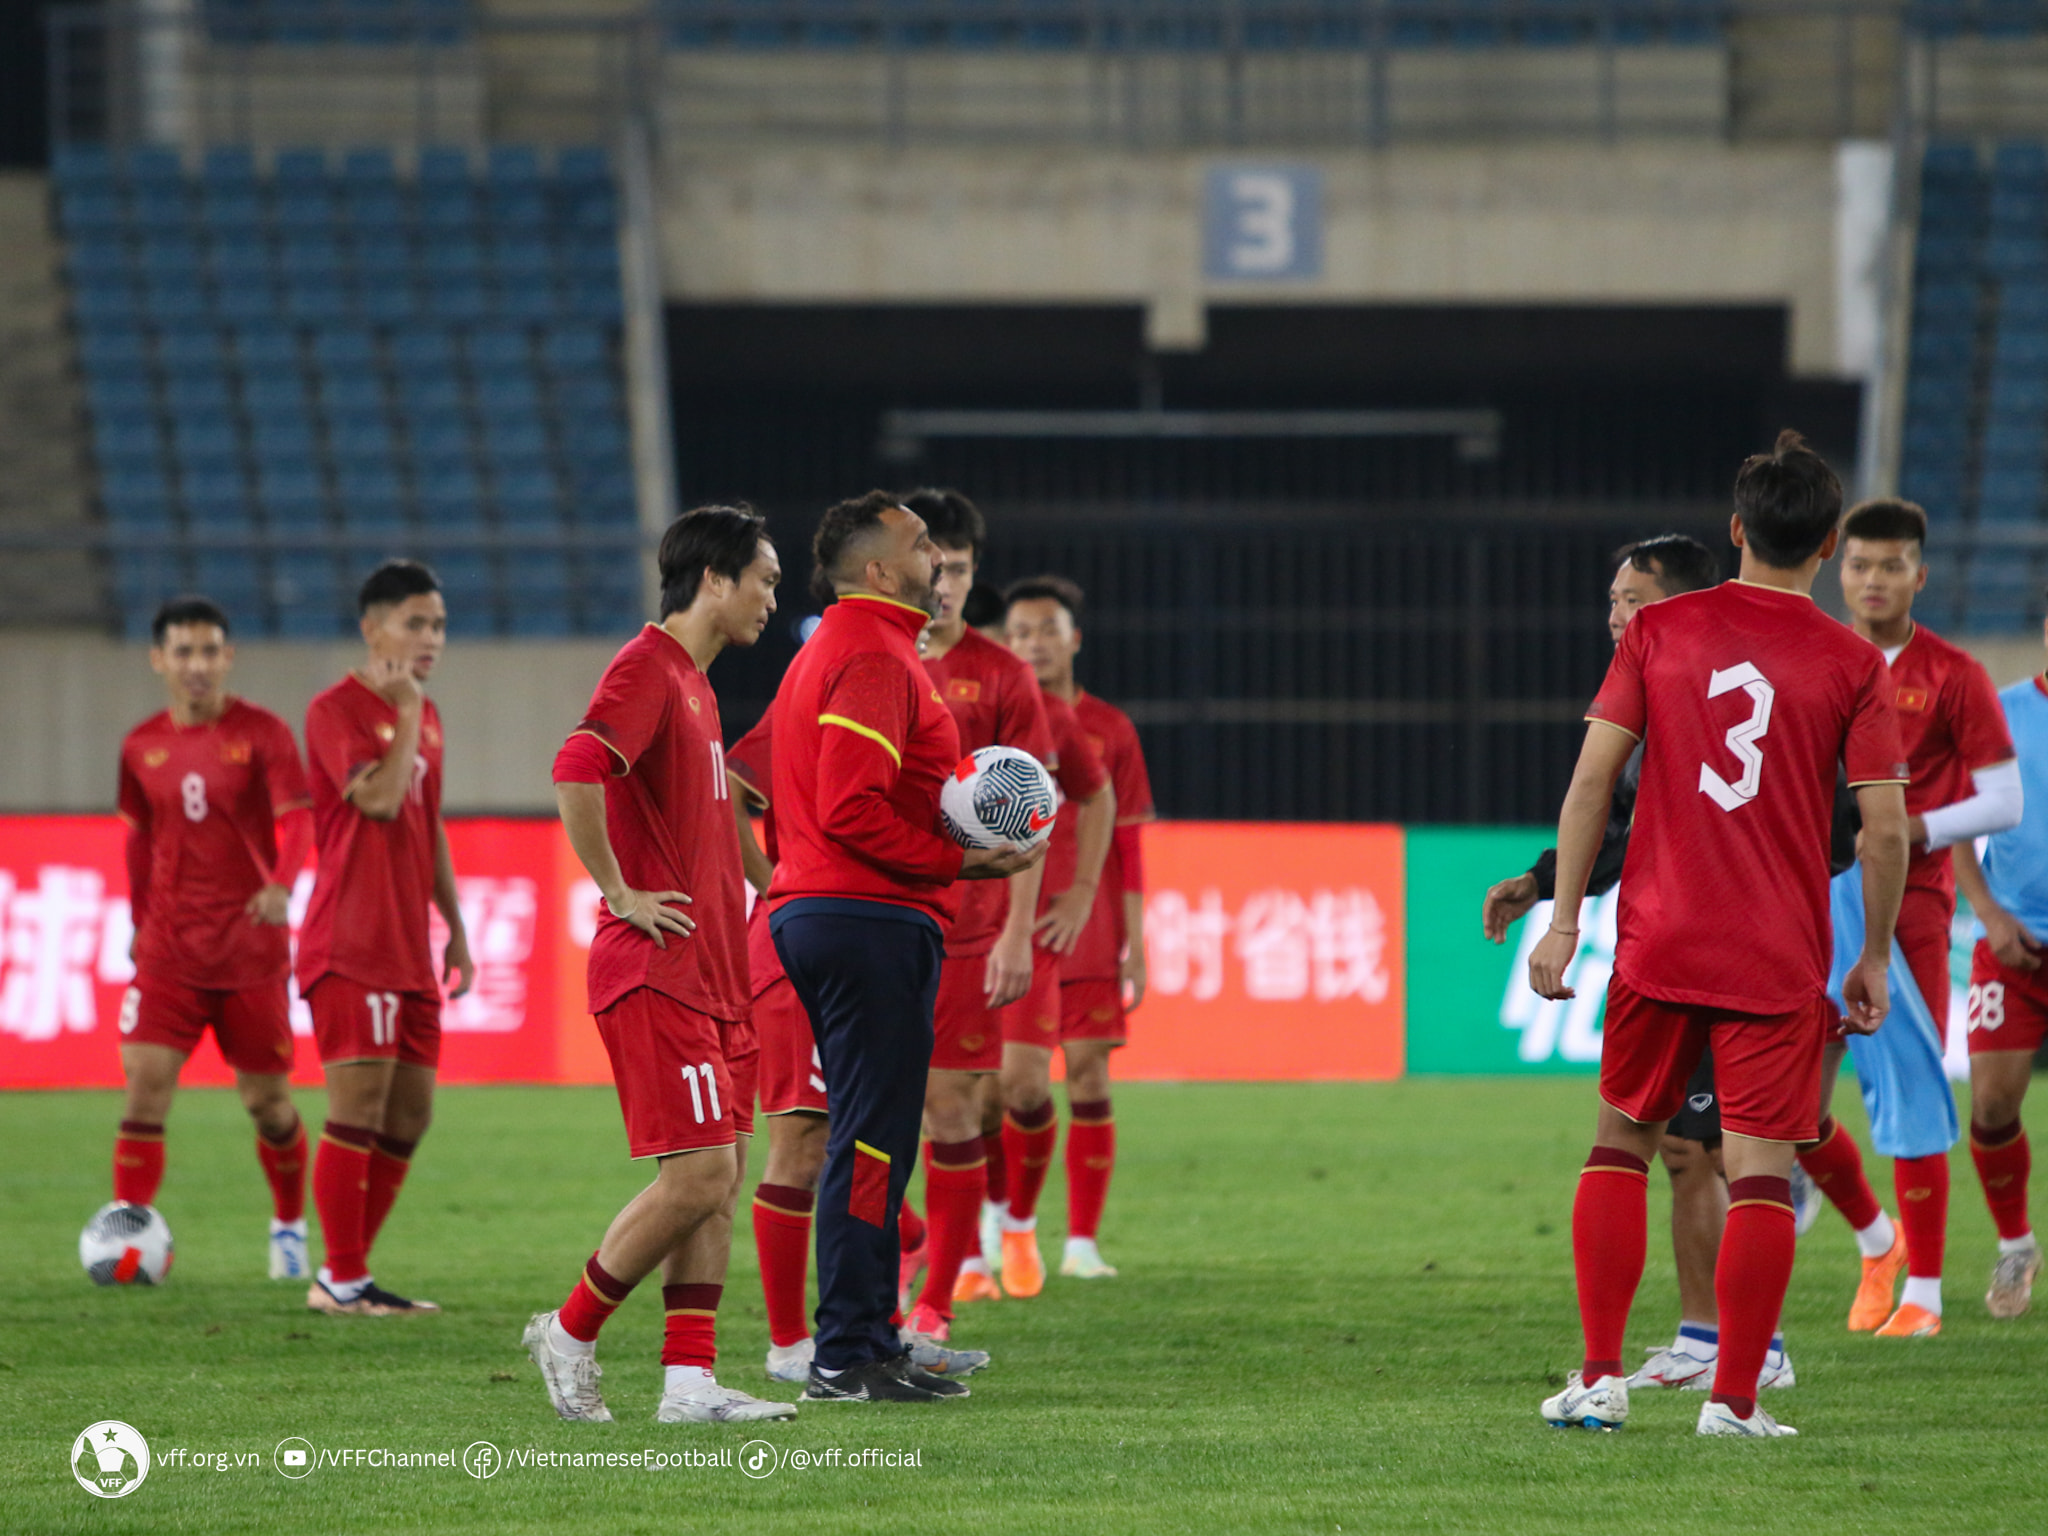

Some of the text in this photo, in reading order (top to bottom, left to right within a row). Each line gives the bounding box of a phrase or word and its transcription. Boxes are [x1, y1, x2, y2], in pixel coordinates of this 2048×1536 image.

[1231, 173, 1296, 272] 3
[1698, 660, 1776, 813] 3
[181, 771, 208, 823] 8
[710, 740, 728, 801] 11
[366, 992, 399, 1046] 17
[1968, 980, 2005, 1034] 28
[681, 1062, 722, 1124] 11
